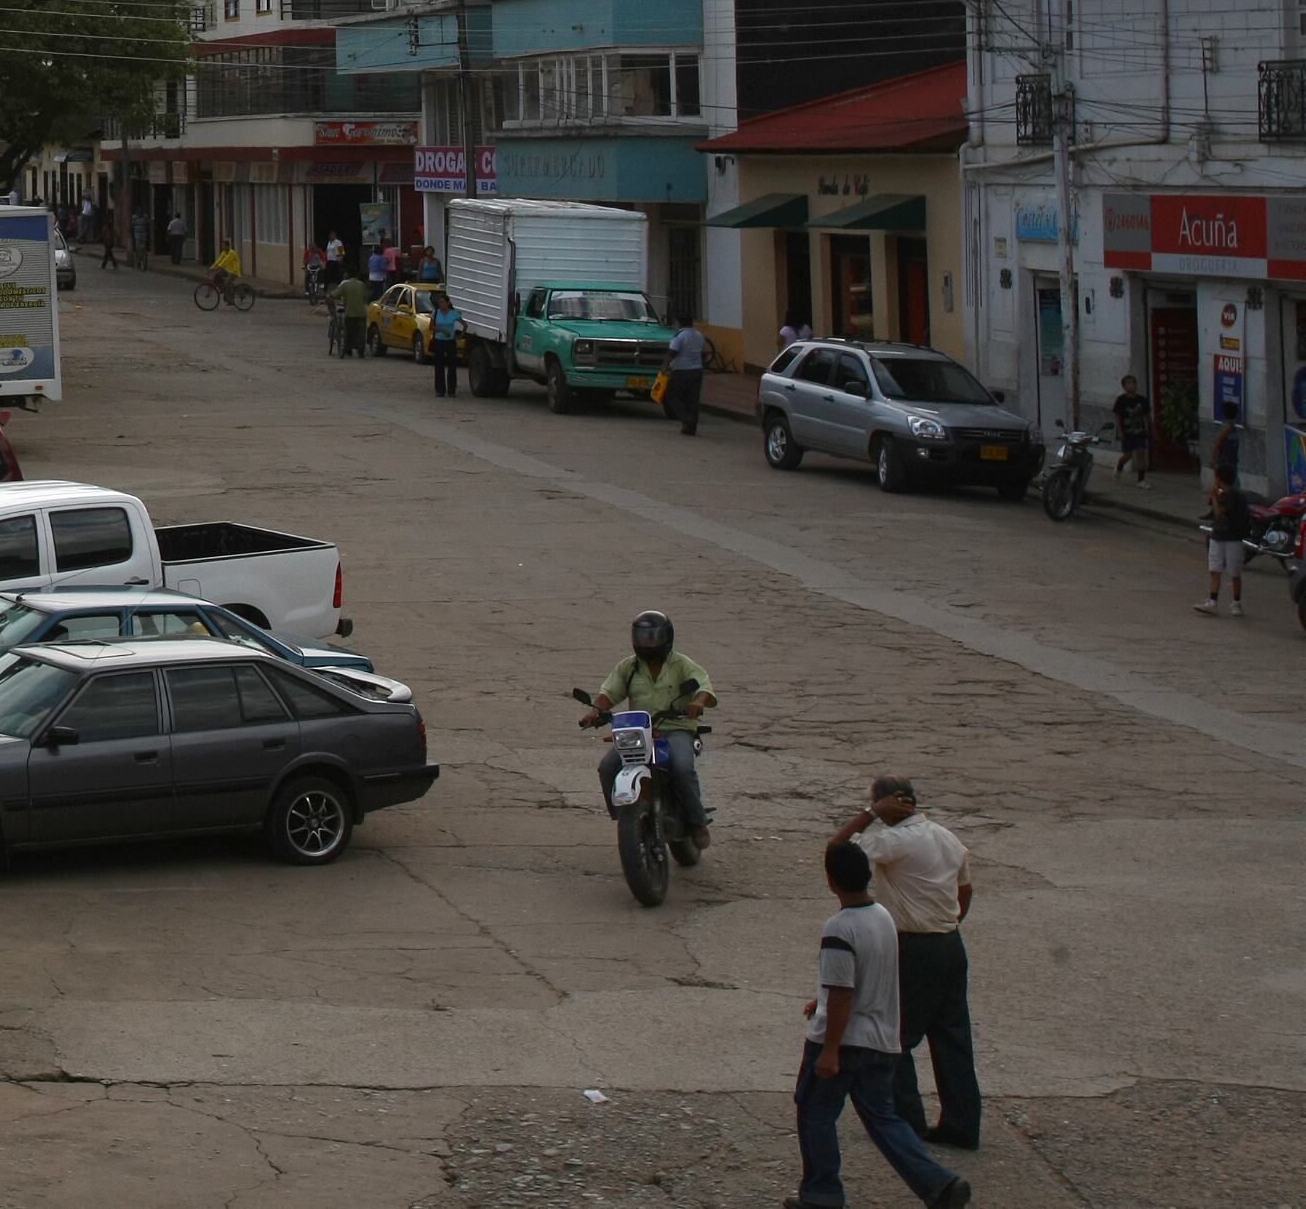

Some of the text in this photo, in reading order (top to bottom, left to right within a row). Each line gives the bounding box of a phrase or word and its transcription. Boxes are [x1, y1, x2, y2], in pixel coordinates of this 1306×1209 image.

[416, 151, 474, 174] DROGA
[416, 180, 450, 190] DONDE
[1178, 206, 1238, 248] Acuña
